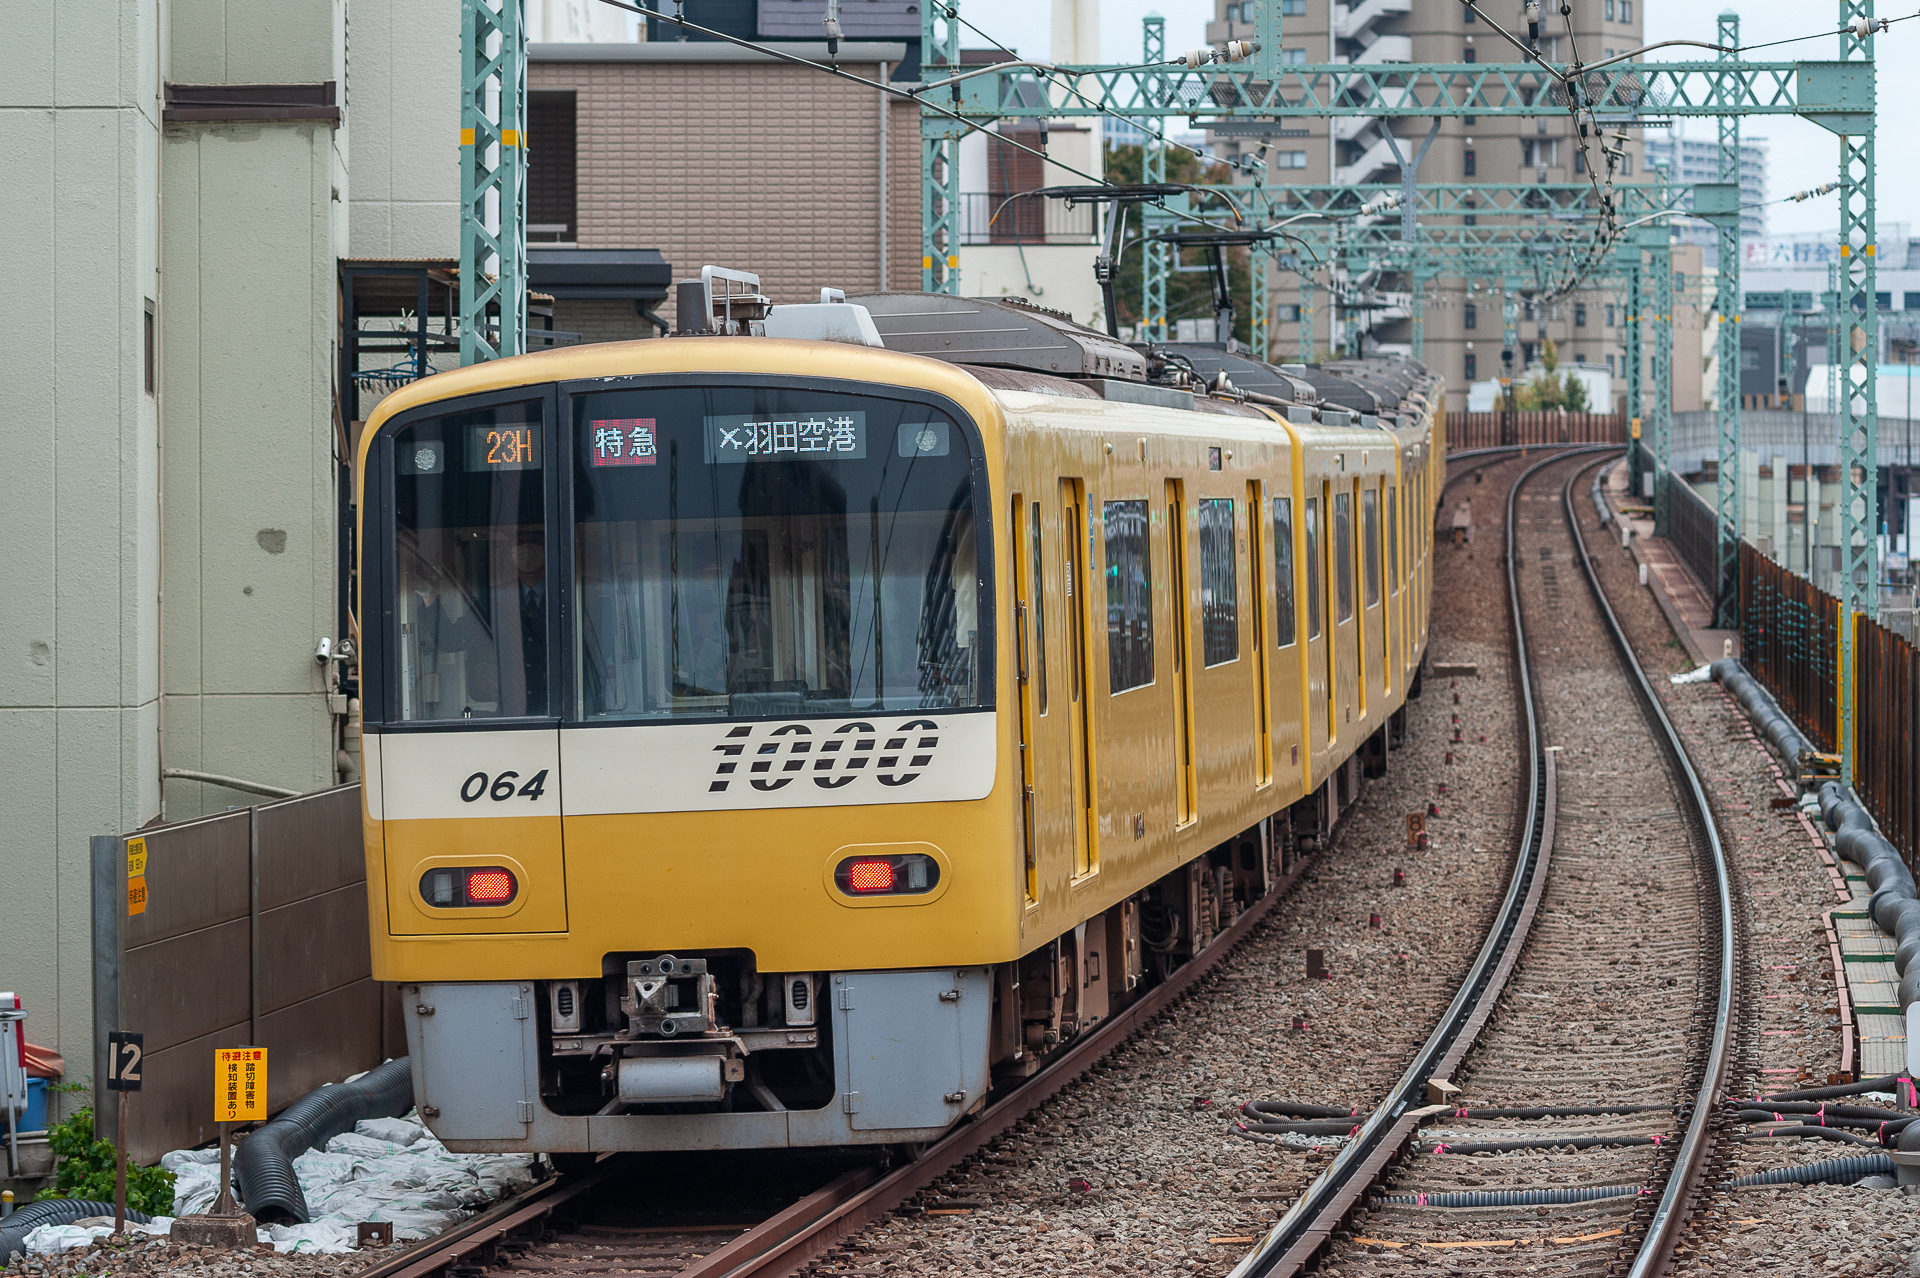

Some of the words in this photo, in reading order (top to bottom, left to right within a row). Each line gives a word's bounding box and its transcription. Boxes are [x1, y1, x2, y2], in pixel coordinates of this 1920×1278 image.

[486, 429, 532, 463] 23H
[595, 426, 657, 458] 特急
[743, 416, 856, 455] 羽田空港
[708, 719, 939, 792] 1000
[460, 769, 549, 803] 064
[109, 1042, 142, 1081] 12
[221, 1051, 262, 1062] 待避注意
[227, 1063, 238, 1119] 検知装置あり
[245, 1062, 256, 1110] 踏切障害物
